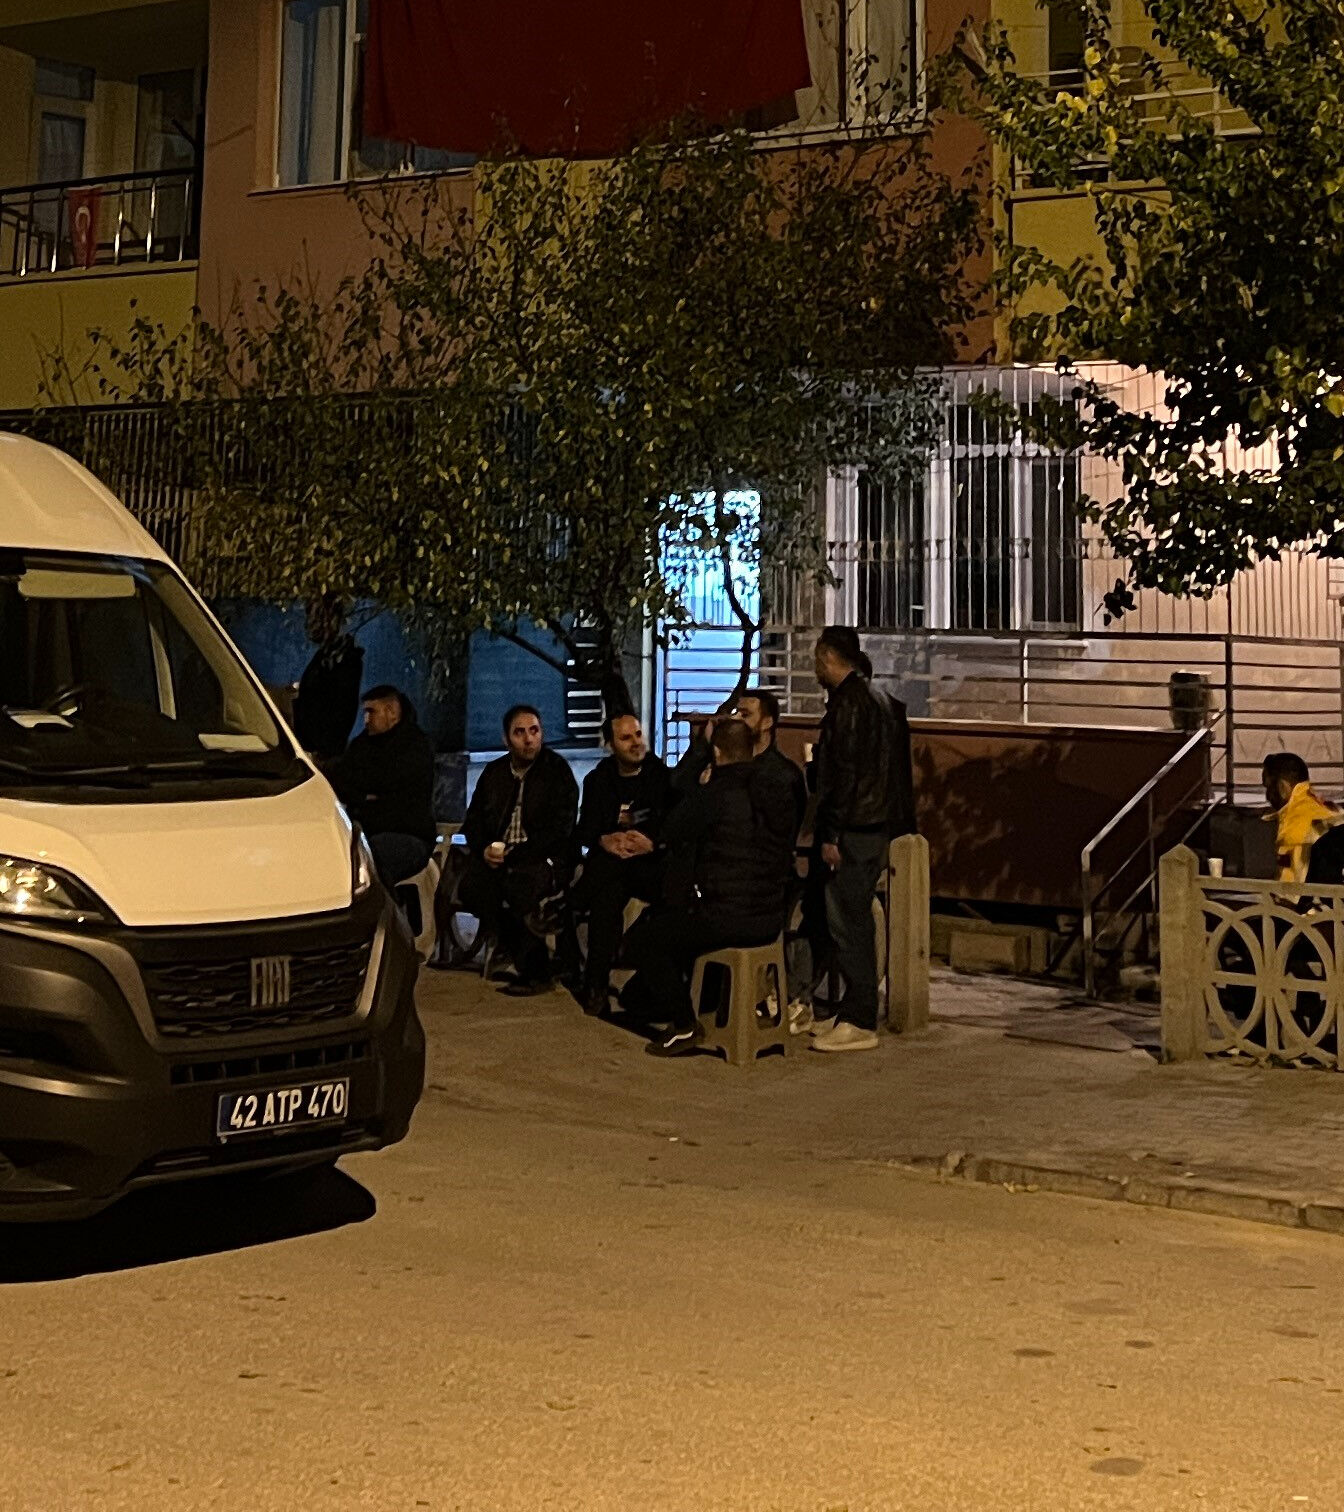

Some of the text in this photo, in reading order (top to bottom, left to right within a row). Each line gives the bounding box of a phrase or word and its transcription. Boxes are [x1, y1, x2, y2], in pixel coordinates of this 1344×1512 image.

[251, 955, 292, 1007] FIAT
[230, 1084, 345, 1128] 42 ATP 470
